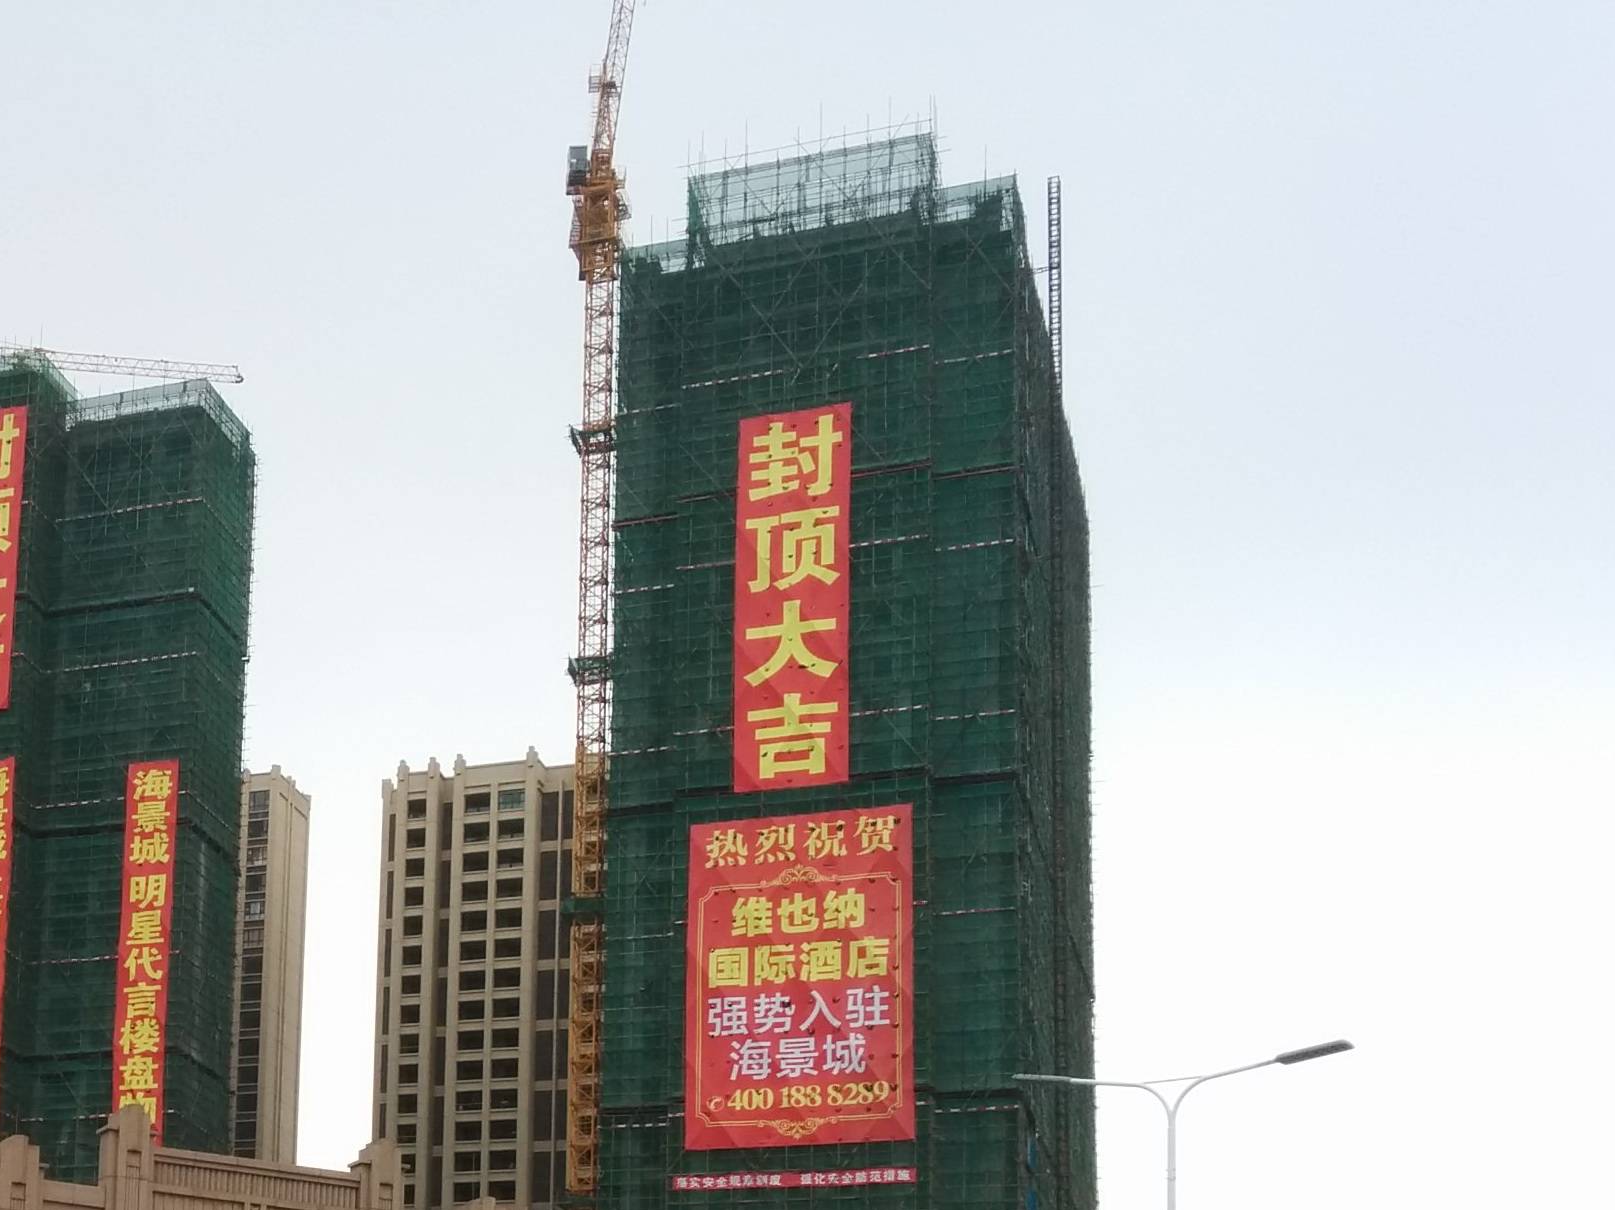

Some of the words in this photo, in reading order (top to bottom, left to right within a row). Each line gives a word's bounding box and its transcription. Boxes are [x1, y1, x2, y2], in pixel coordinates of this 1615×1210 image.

[745, 414, 842, 779] 封顶大吉
[130, 770, 171, 864] 海景城
[705, 814, 895, 868] 热烈祝贺
[731, 888, 865, 937] 维也纳
[708, 936, 890, 988] 国际酒店
[707, 986, 890, 1037] 强势入驻
[730, 1033, 866, 1081] 海景城
[727, 1087, 773, 1110] 400
[780, 1084, 821, 1108] 188
[827, 1080, 888, 1105] 8289
